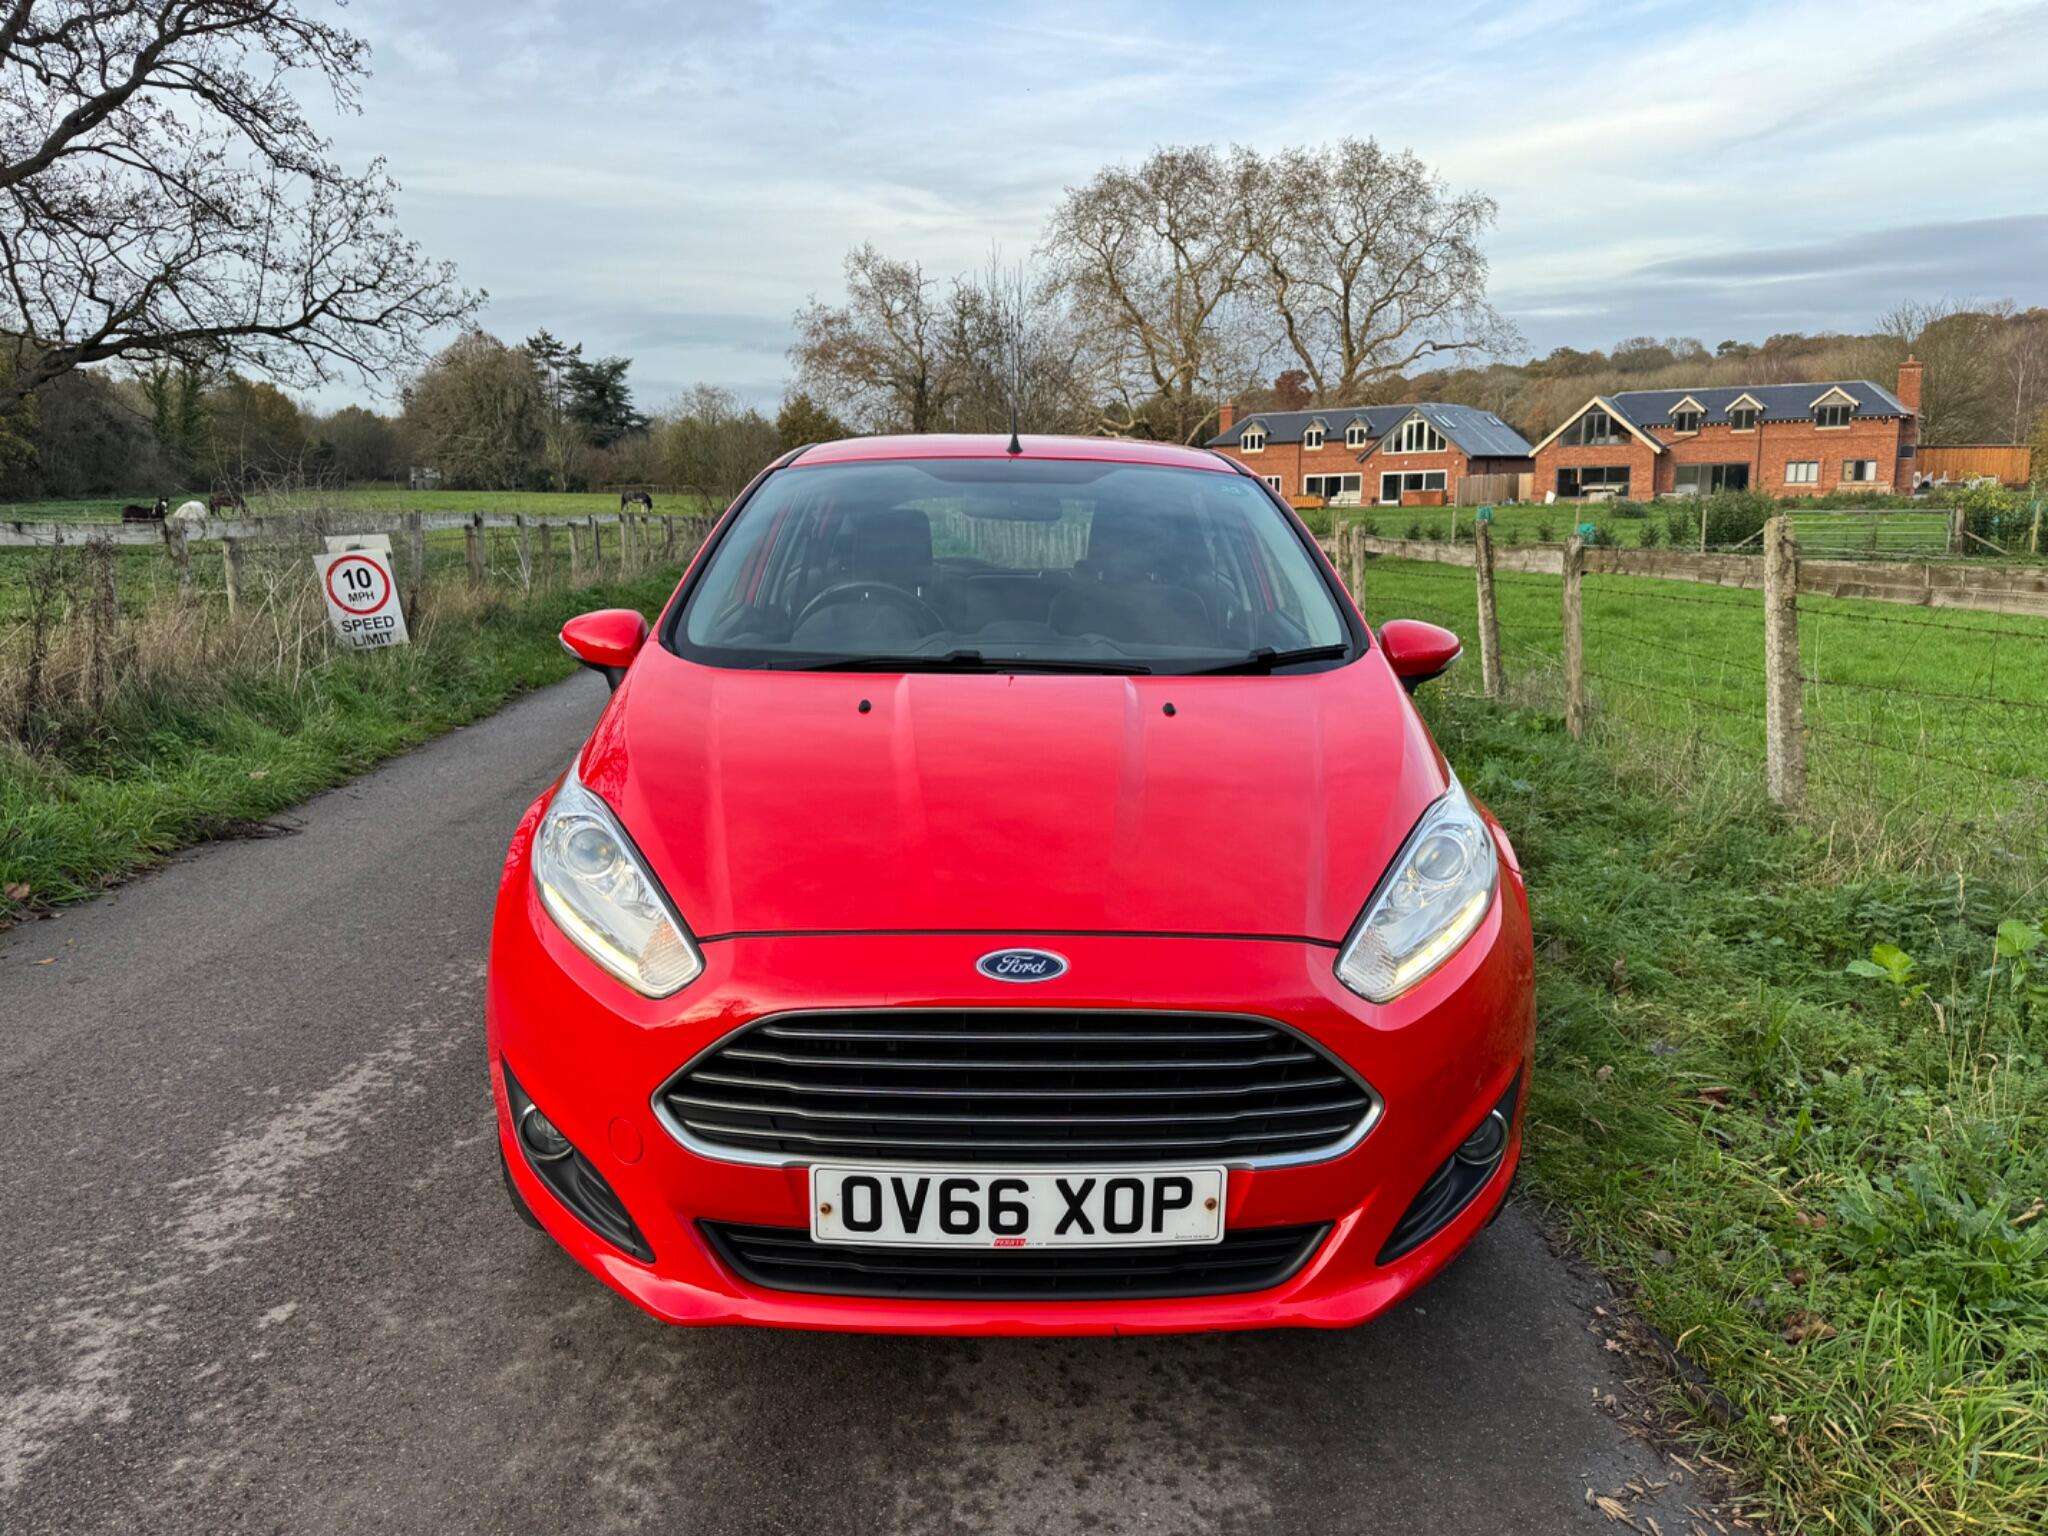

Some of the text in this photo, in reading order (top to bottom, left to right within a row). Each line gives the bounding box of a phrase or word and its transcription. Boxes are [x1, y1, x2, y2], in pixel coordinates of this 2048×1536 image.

[342, 567, 372, 590] 10
[348, 591, 375, 602] MPH
[341, 615, 395, 632] SPEED
[351, 631, 392, 647] LIMIT
[996, 954, 1046, 973] Ford
[841, 1175, 1193, 1236] OV66 XOP
